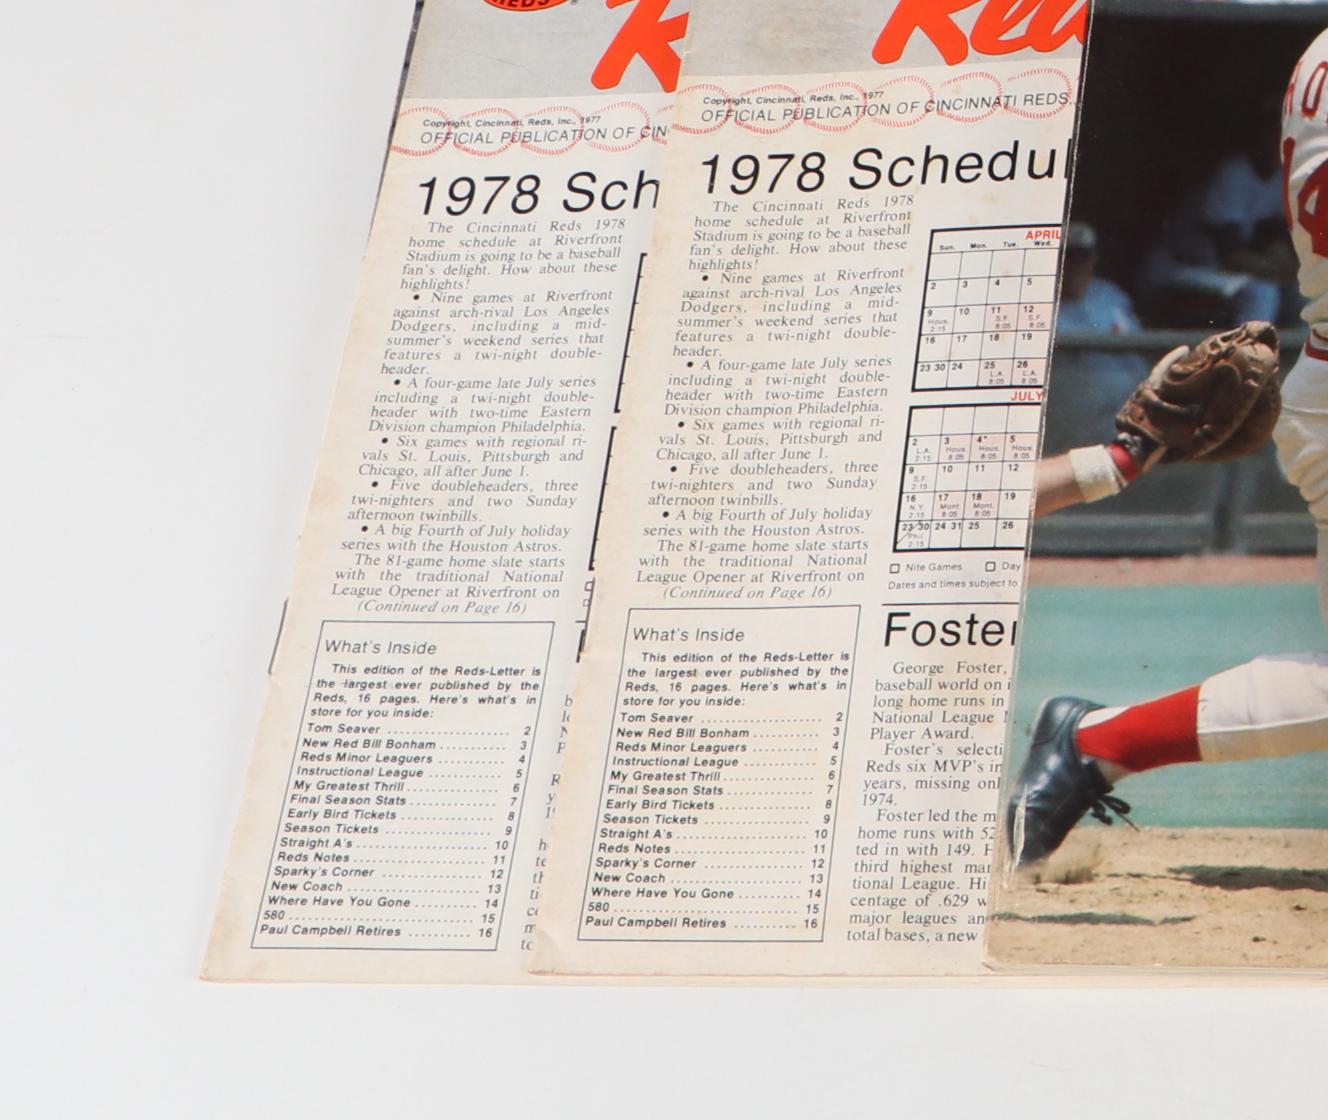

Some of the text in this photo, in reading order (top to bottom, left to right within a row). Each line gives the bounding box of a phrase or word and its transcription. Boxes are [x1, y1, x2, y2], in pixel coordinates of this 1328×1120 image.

[701, 94, 1017, 122] OFFICIAL PUBLICATION OF CINCINNATI
[702, 151, 826, 195] 1978
[713, 194, 914, 212] The Cincinnati Reds 1978
[633, 627, 745, 641] What's Inside
